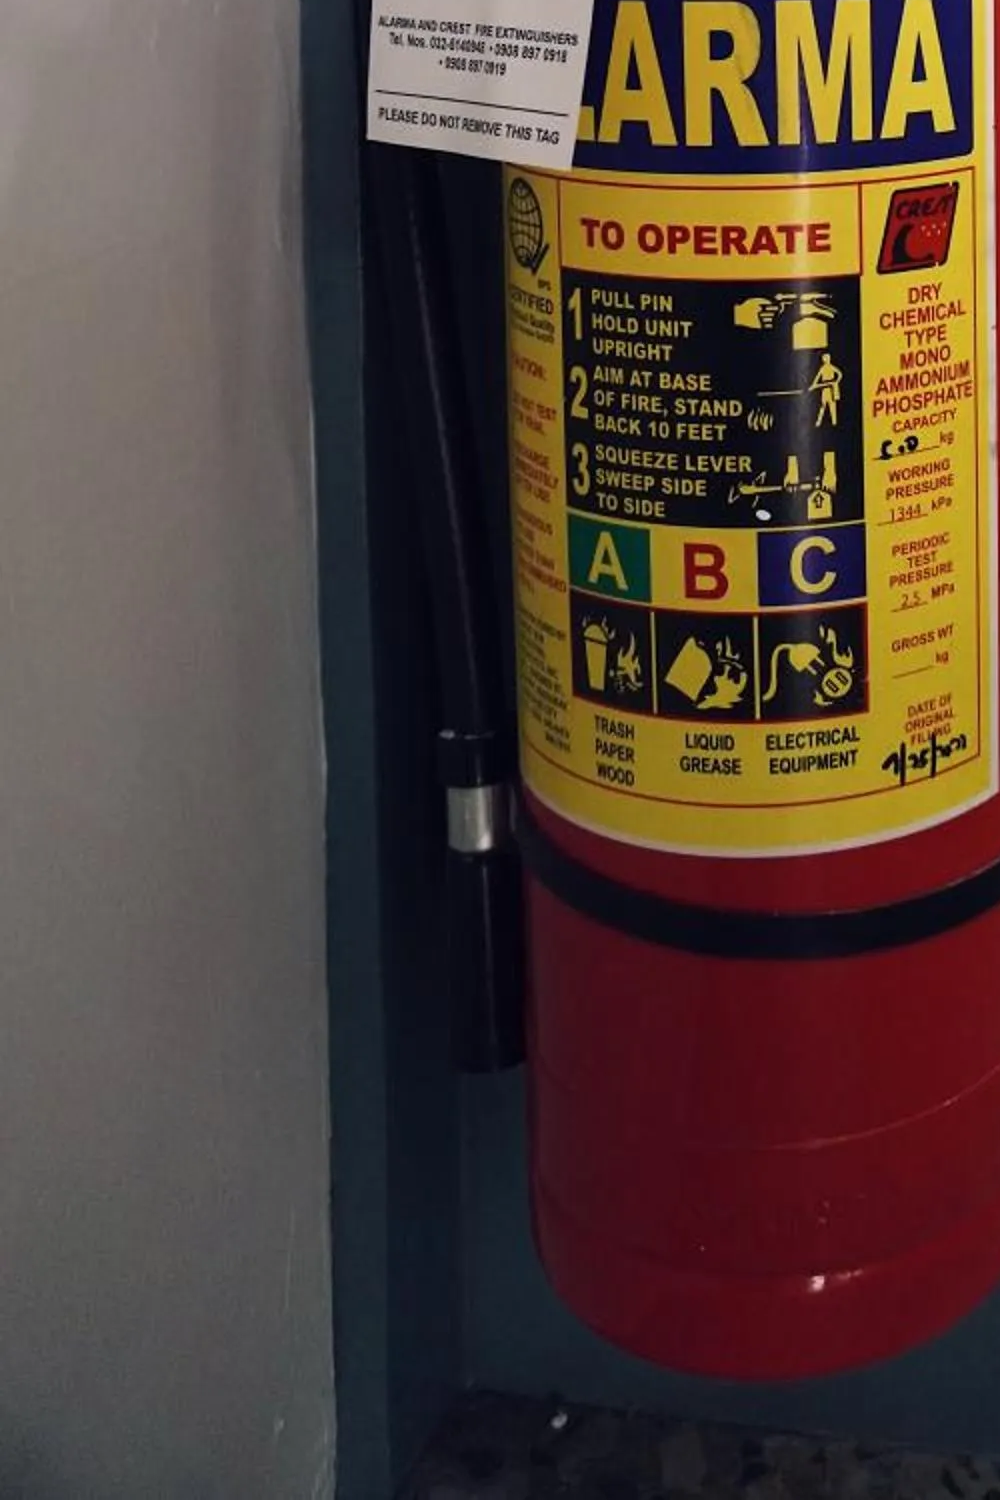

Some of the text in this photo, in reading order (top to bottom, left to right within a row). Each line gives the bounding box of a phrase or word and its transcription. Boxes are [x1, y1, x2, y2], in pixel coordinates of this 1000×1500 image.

[378, 15, 579, 46] ALARMA AND CREST FIRE EXTINGUISHERS
[378, 107, 561, 145] PLEASE DO NOT REMOVE THIS TAG
[580, 218, 832, 257] TO OPERATE
[591, 289, 673, 313] PULL PIN
[907, 282, 943, 306] DRY
[568, 287, 583, 341] 1
[591, 313, 693, 339] HOLD UNIT
[879, 300, 967, 331] CHEMICAL
[903, 323, 948, 349] TYPE
[592, 339, 673, 361] UPRIGHT
[899, 344, 951, 371] MONO
[592, 365, 713, 393] AIM AT BASE
[874, 360, 971, 397] AMMONIUM
[569, 365, 589, 421] 2
[593, 390, 743, 419] OF FIRE, STAND
[872, 379, 974, 419] PHOSPHATE
[594, 415, 728, 442] BACK 10 FEET
[892, 407, 958, 435] CAPACITY
[939, 428, 956, 448] kg
[571, 442, 591, 498] 3
[595, 443, 753, 474] SQUEEZE LEVER
[887, 457, 952, 484] WORKING
[595, 467, 708, 498] SWEEP SIDE
[885, 473, 956, 500] PRESSURE
[596, 491, 666, 518] TO SIDE
[931, 496, 953, 512] kPa
[891, 531, 951, 558] PERIODIC
[588, 531, 630, 592] A
[683, 542, 730, 600] B
[789, 535, 838, 596] C
[907, 550, 938, 570] TEST
[889, 561, 955, 589] PRESSURE
[931, 582, 956, 601] MPa
[891, 623, 955, 653] GROSS WT
[935, 649, 950, 665] kg
[907, 693, 953, 719] DATE OF
[594, 715, 636, 741] TRASH
[904, 708, 956, 734] ORIGINAL
[684, 732, 736, 752] LIQUID
[765, 725, 862, 751] ELECTRICAL
[595, 739, 636, 765] PAPER
[769, 749, 860, 776] EQUIPMENT
[595, 761, 636, 788] WOOD
[679, 755, 743, 777] GREASE
